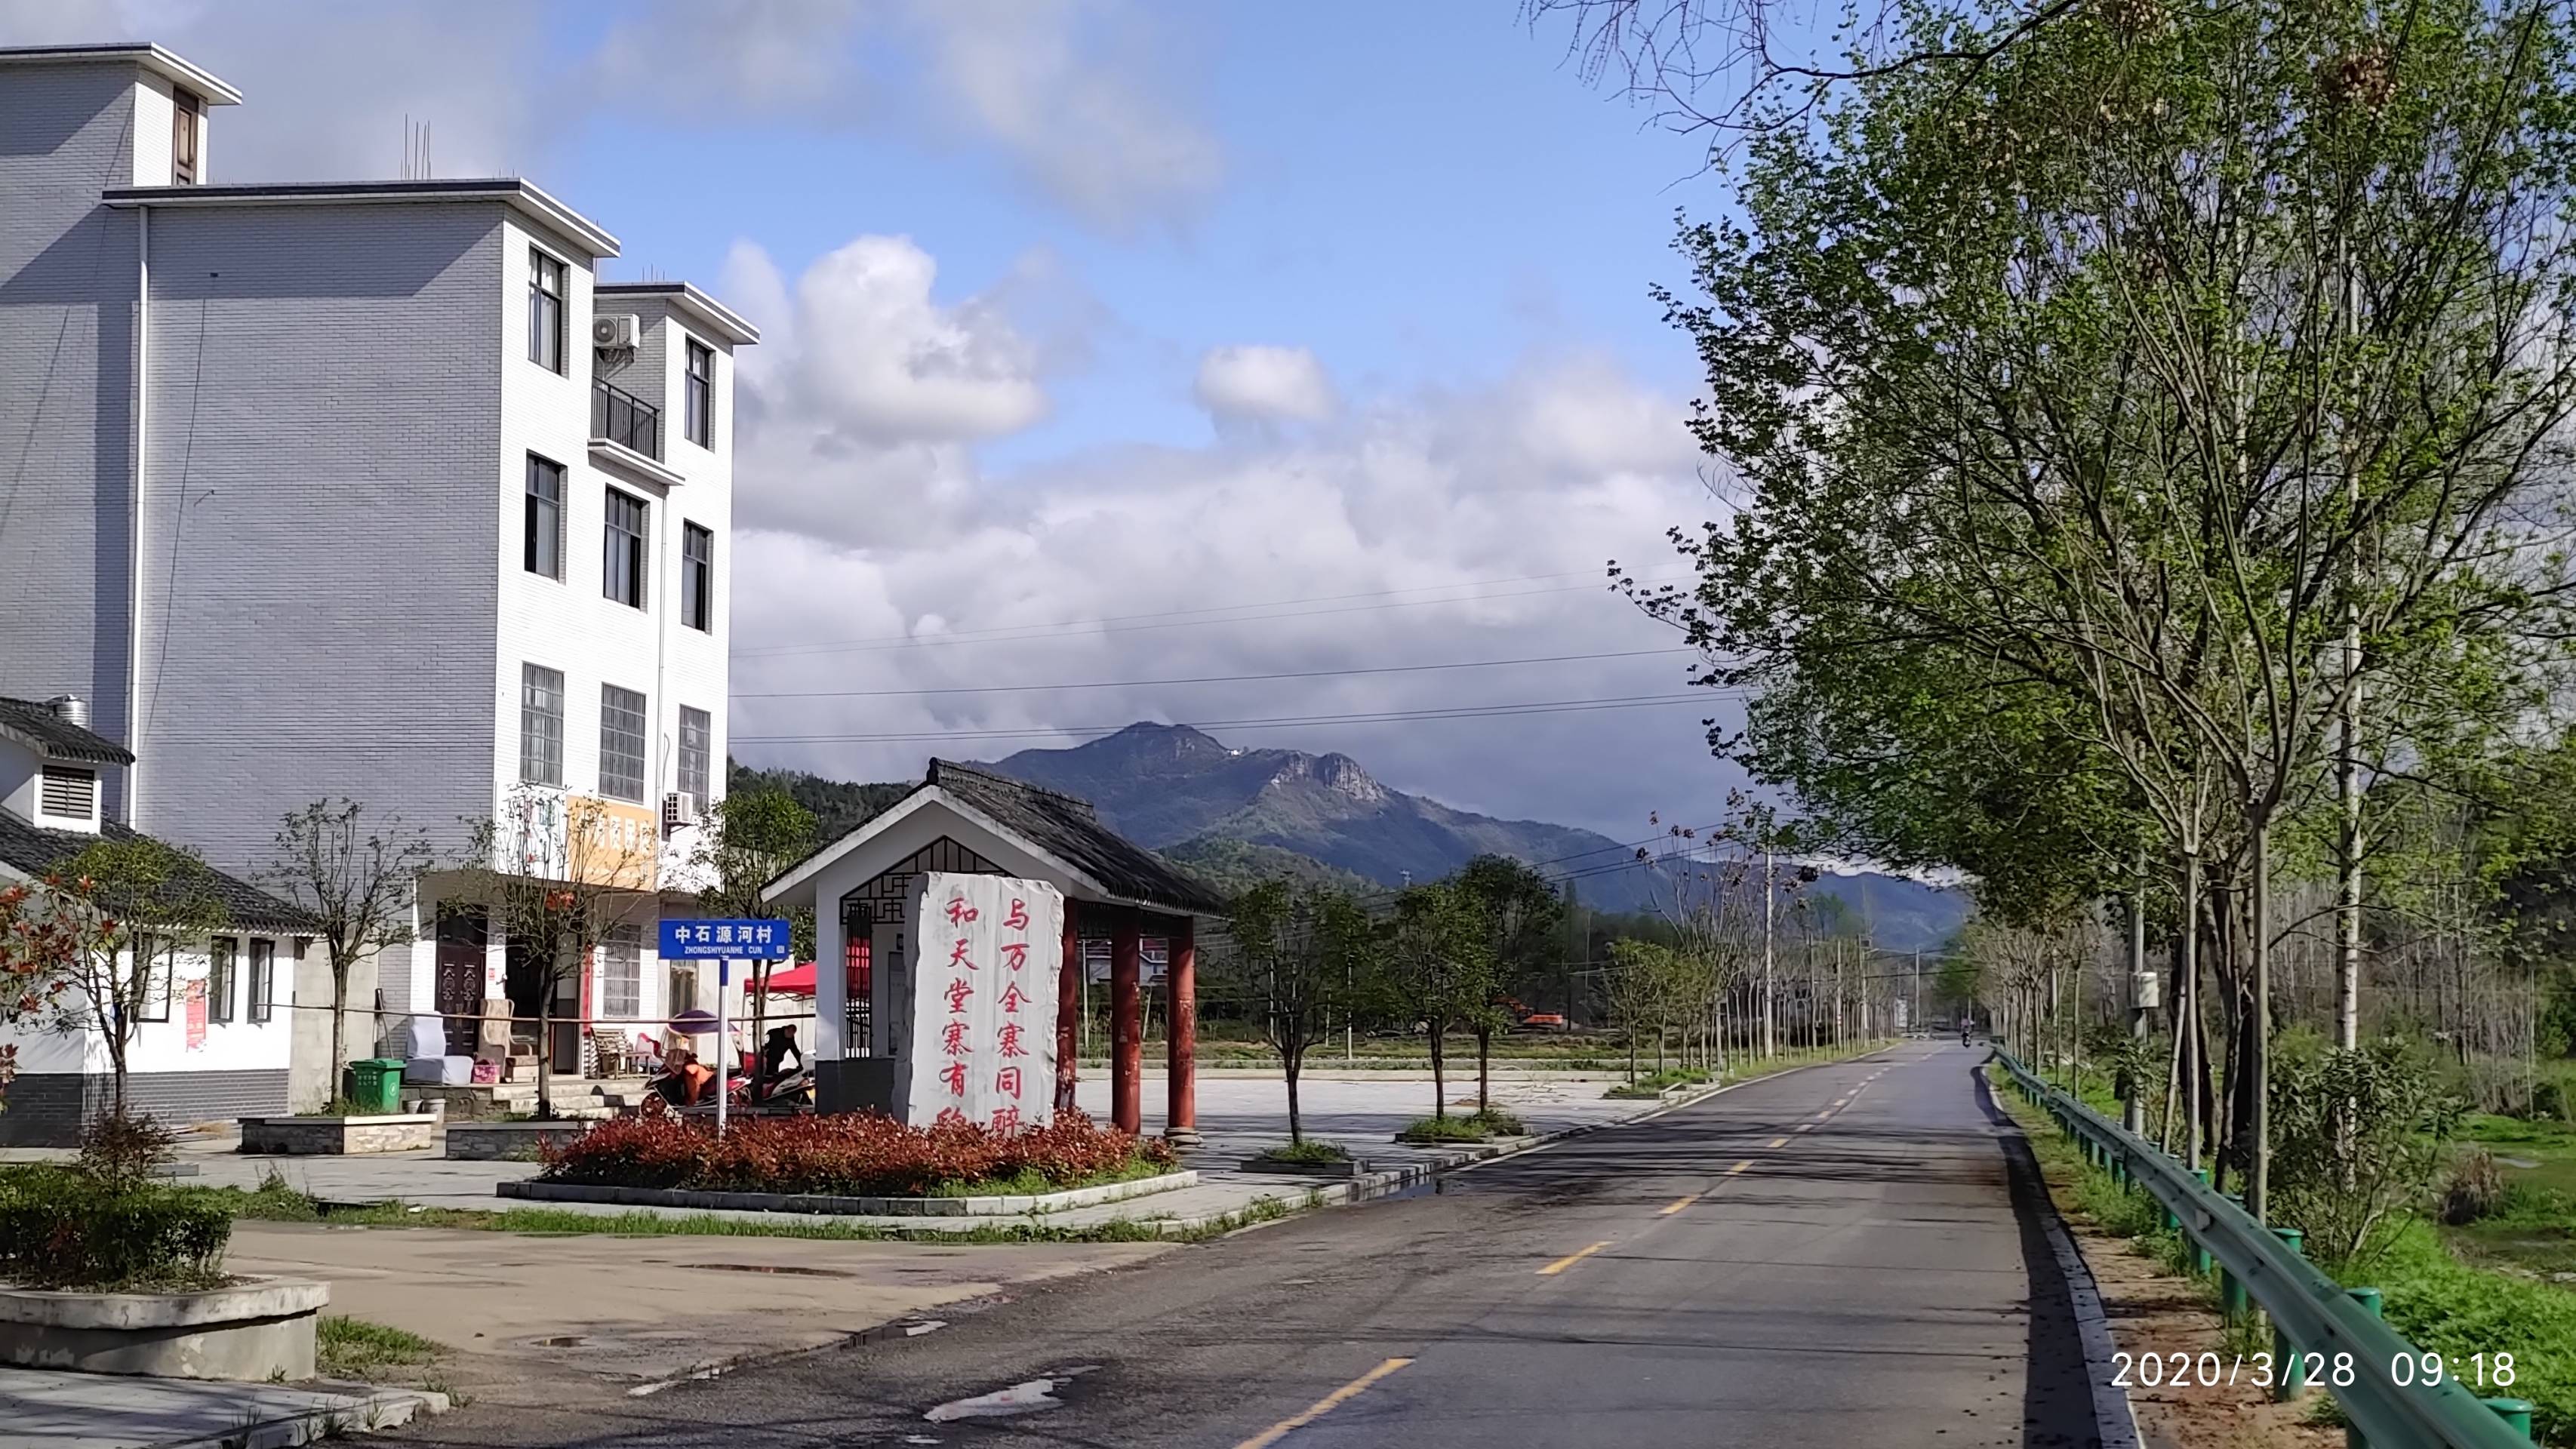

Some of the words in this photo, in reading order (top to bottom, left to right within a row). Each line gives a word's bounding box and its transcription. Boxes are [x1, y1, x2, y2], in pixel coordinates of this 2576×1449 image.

[675, 925, 773, 944] 中石源河村
[684, 946, 743, 955] ZHONGSHIYUANHE
[748, 946, 763, 955] CUN
[990, 898, 1032, 1139] 与万全寨同醉
